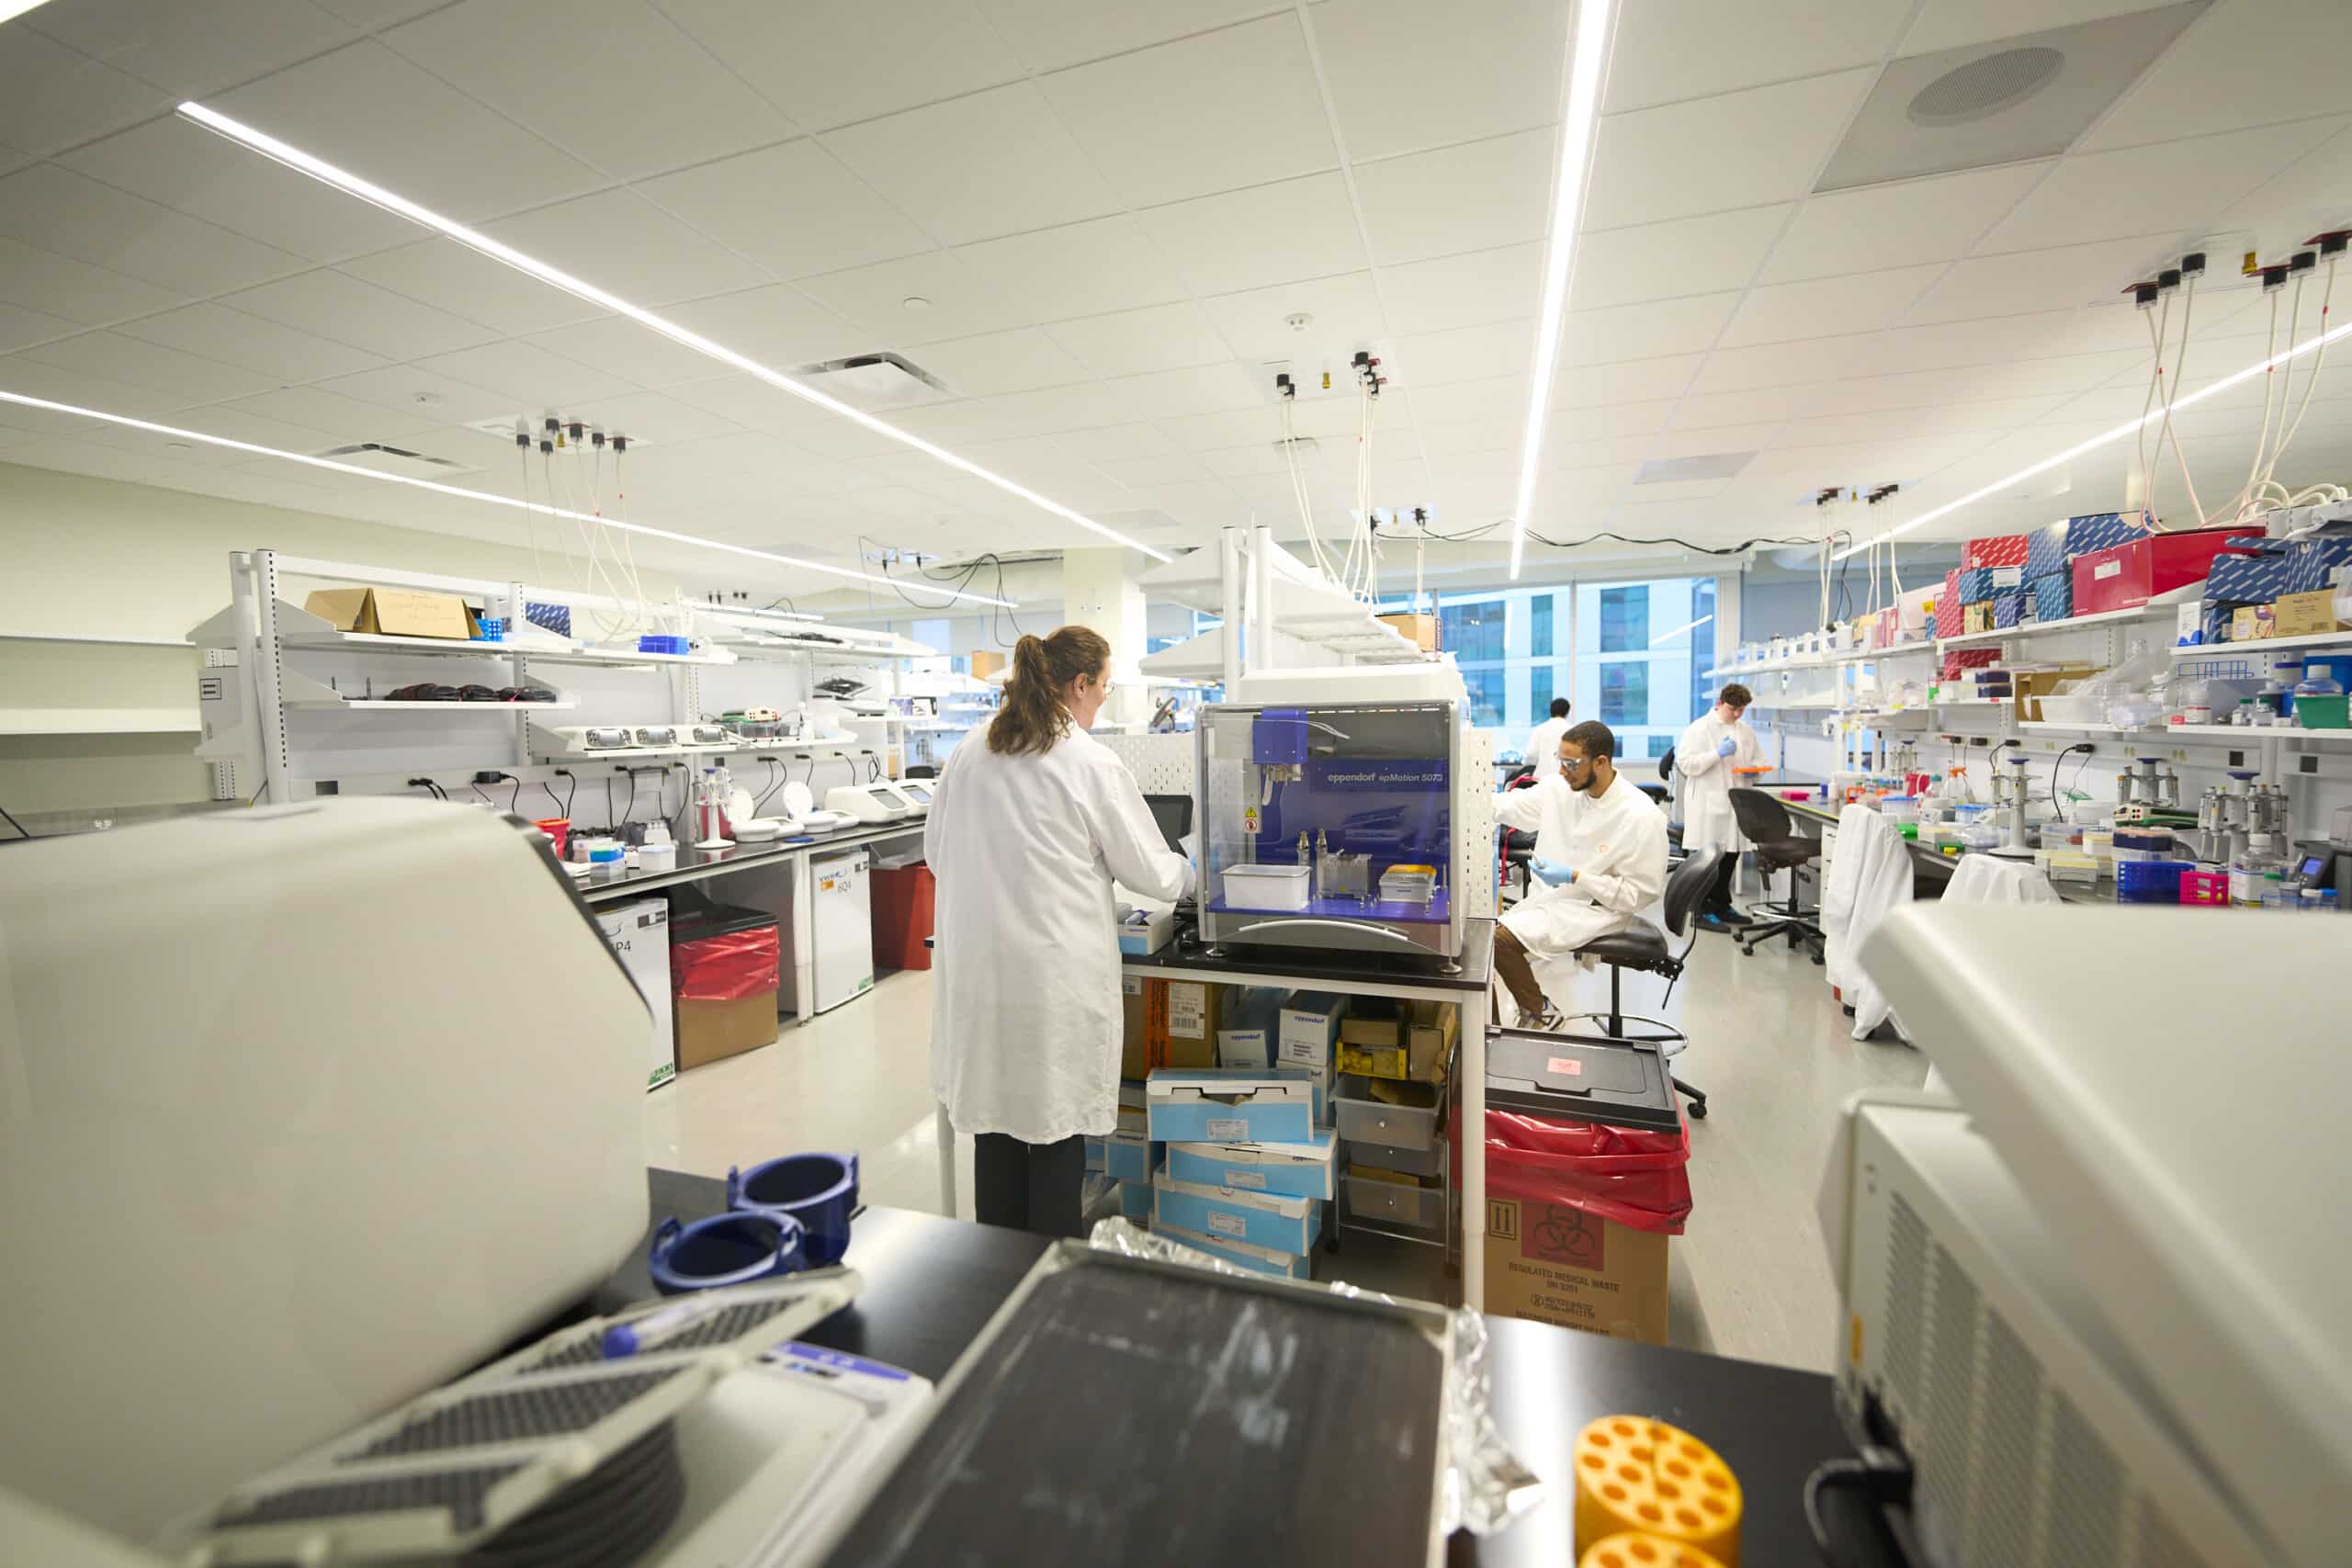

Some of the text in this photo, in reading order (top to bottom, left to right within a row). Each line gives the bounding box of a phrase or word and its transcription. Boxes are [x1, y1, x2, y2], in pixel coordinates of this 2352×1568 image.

[1328, 773, 1443, 784] eppendorf epMotion 5073
[1294, 1015, 1325, 1023] eppendorf
[1508, 1262, 1553, 1278] REGULATED
[1590, 1278, 1621, 1293] WASTE
